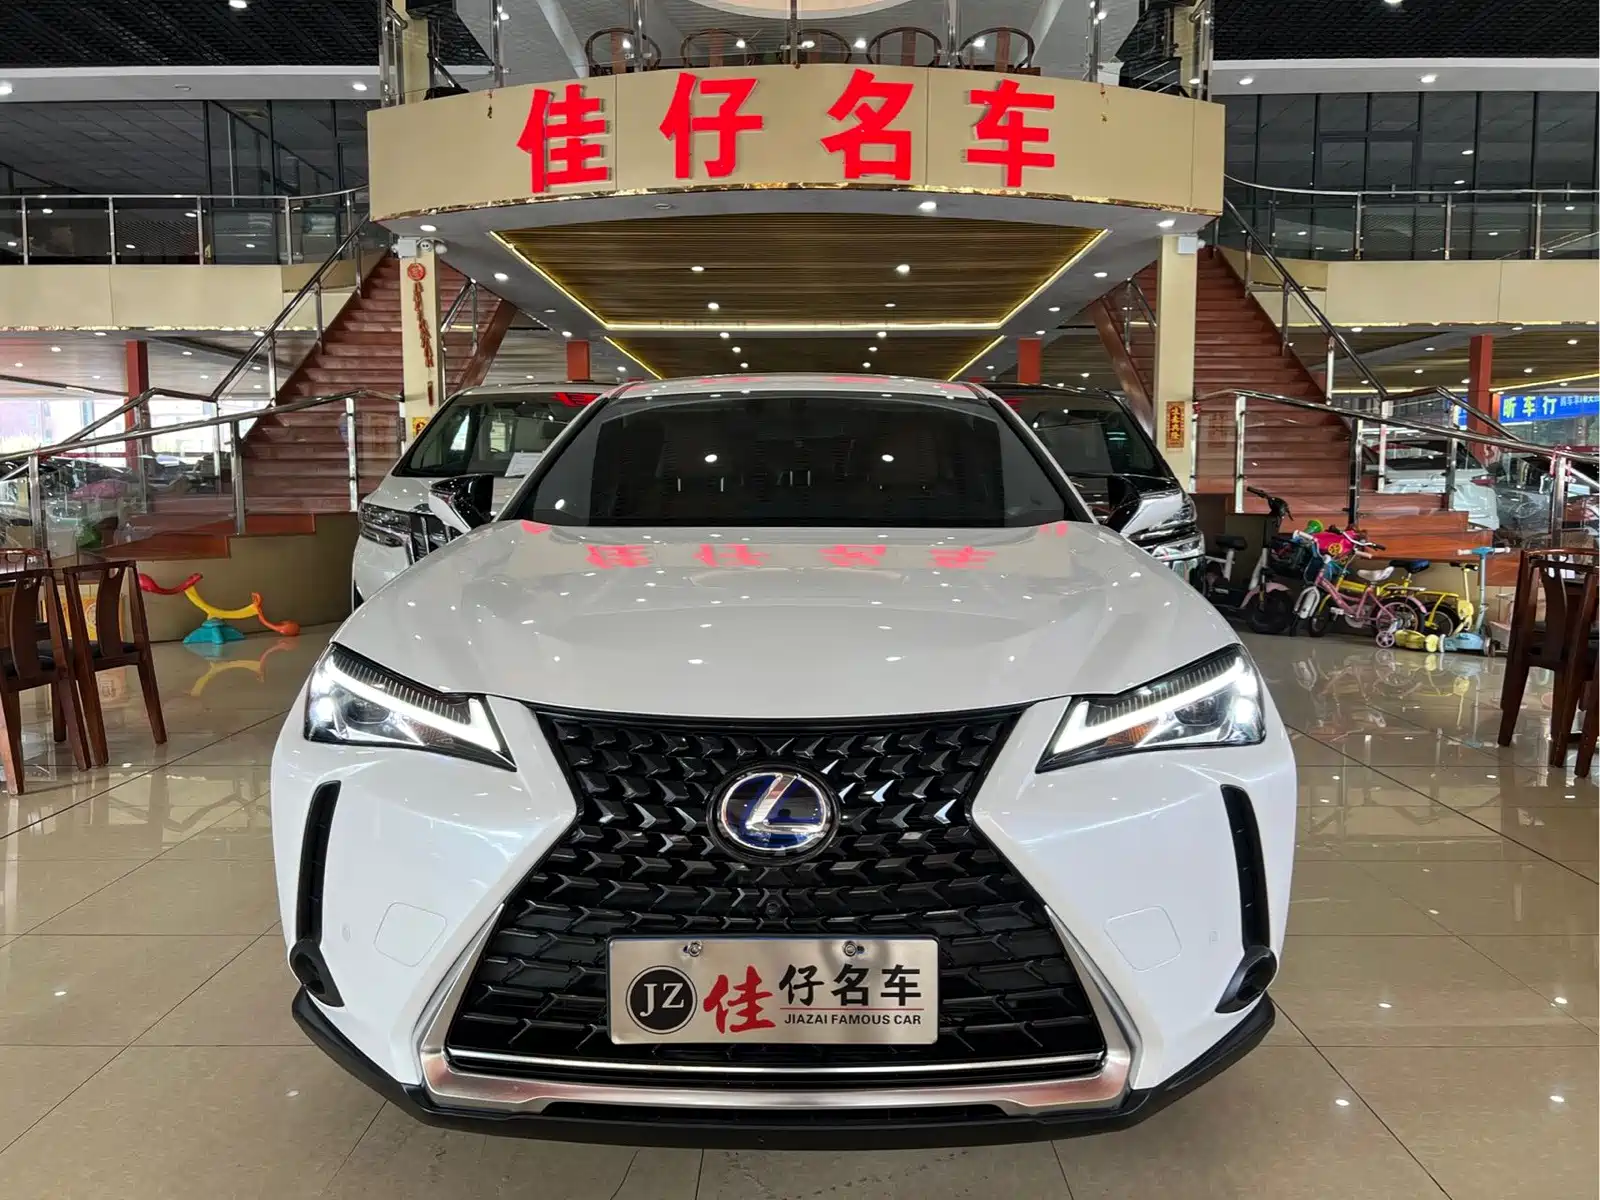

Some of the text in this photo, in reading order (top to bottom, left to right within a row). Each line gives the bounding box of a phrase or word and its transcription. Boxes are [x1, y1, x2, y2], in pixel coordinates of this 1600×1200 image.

[516, 69, 1056, 194] 佳仔名车
[640, 982, 685, 1017] JZ
[784, 1013, 921, 1025] JIAZAI FAMOUS CAR
